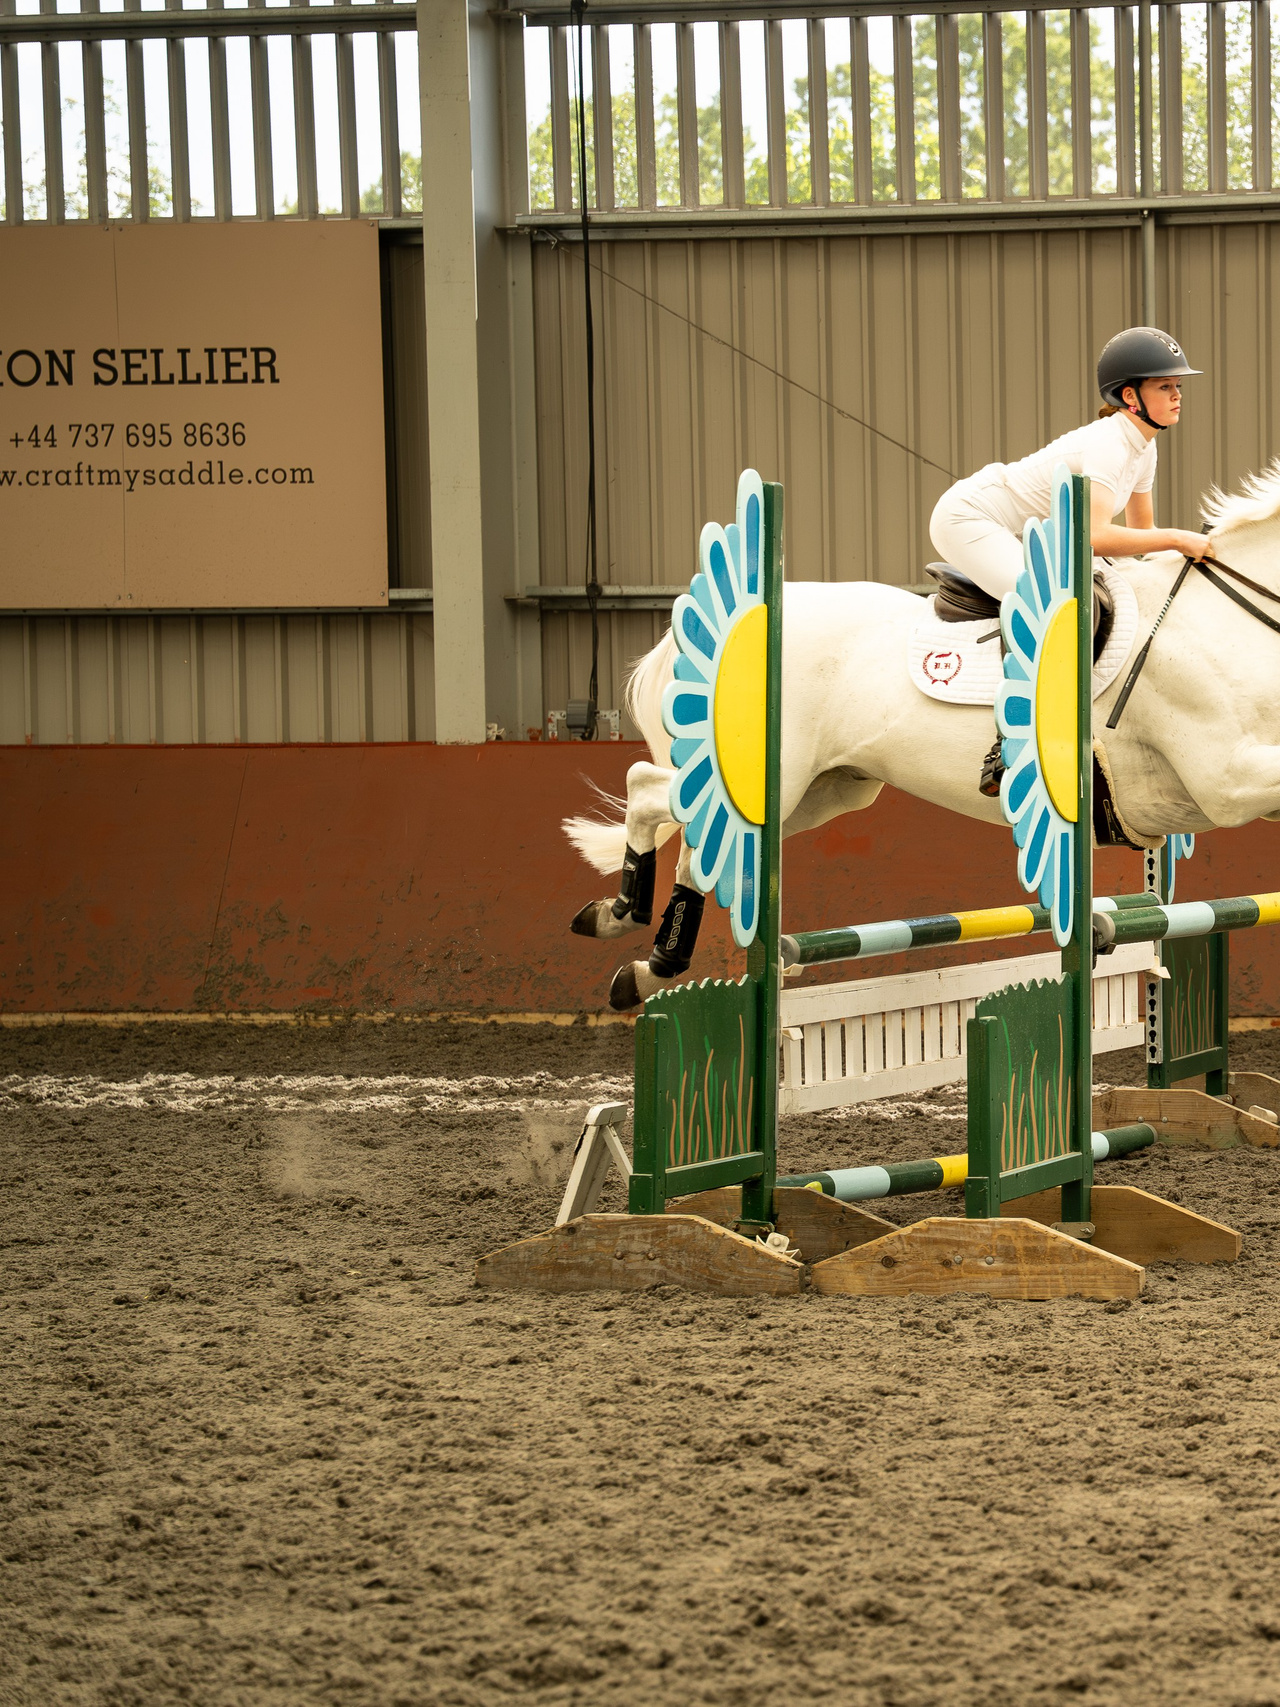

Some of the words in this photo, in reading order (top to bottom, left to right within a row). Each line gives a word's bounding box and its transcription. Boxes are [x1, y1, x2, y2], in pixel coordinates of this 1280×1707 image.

[0, 348, 76, 388] ON
[92, 346, 280, 387] SELLIER
[9, 424, 58, 449] +44
[68, 423, 115, 448] 737
[125, 422, 173, 448] 695
[183, 421, 247, 448] 8636
